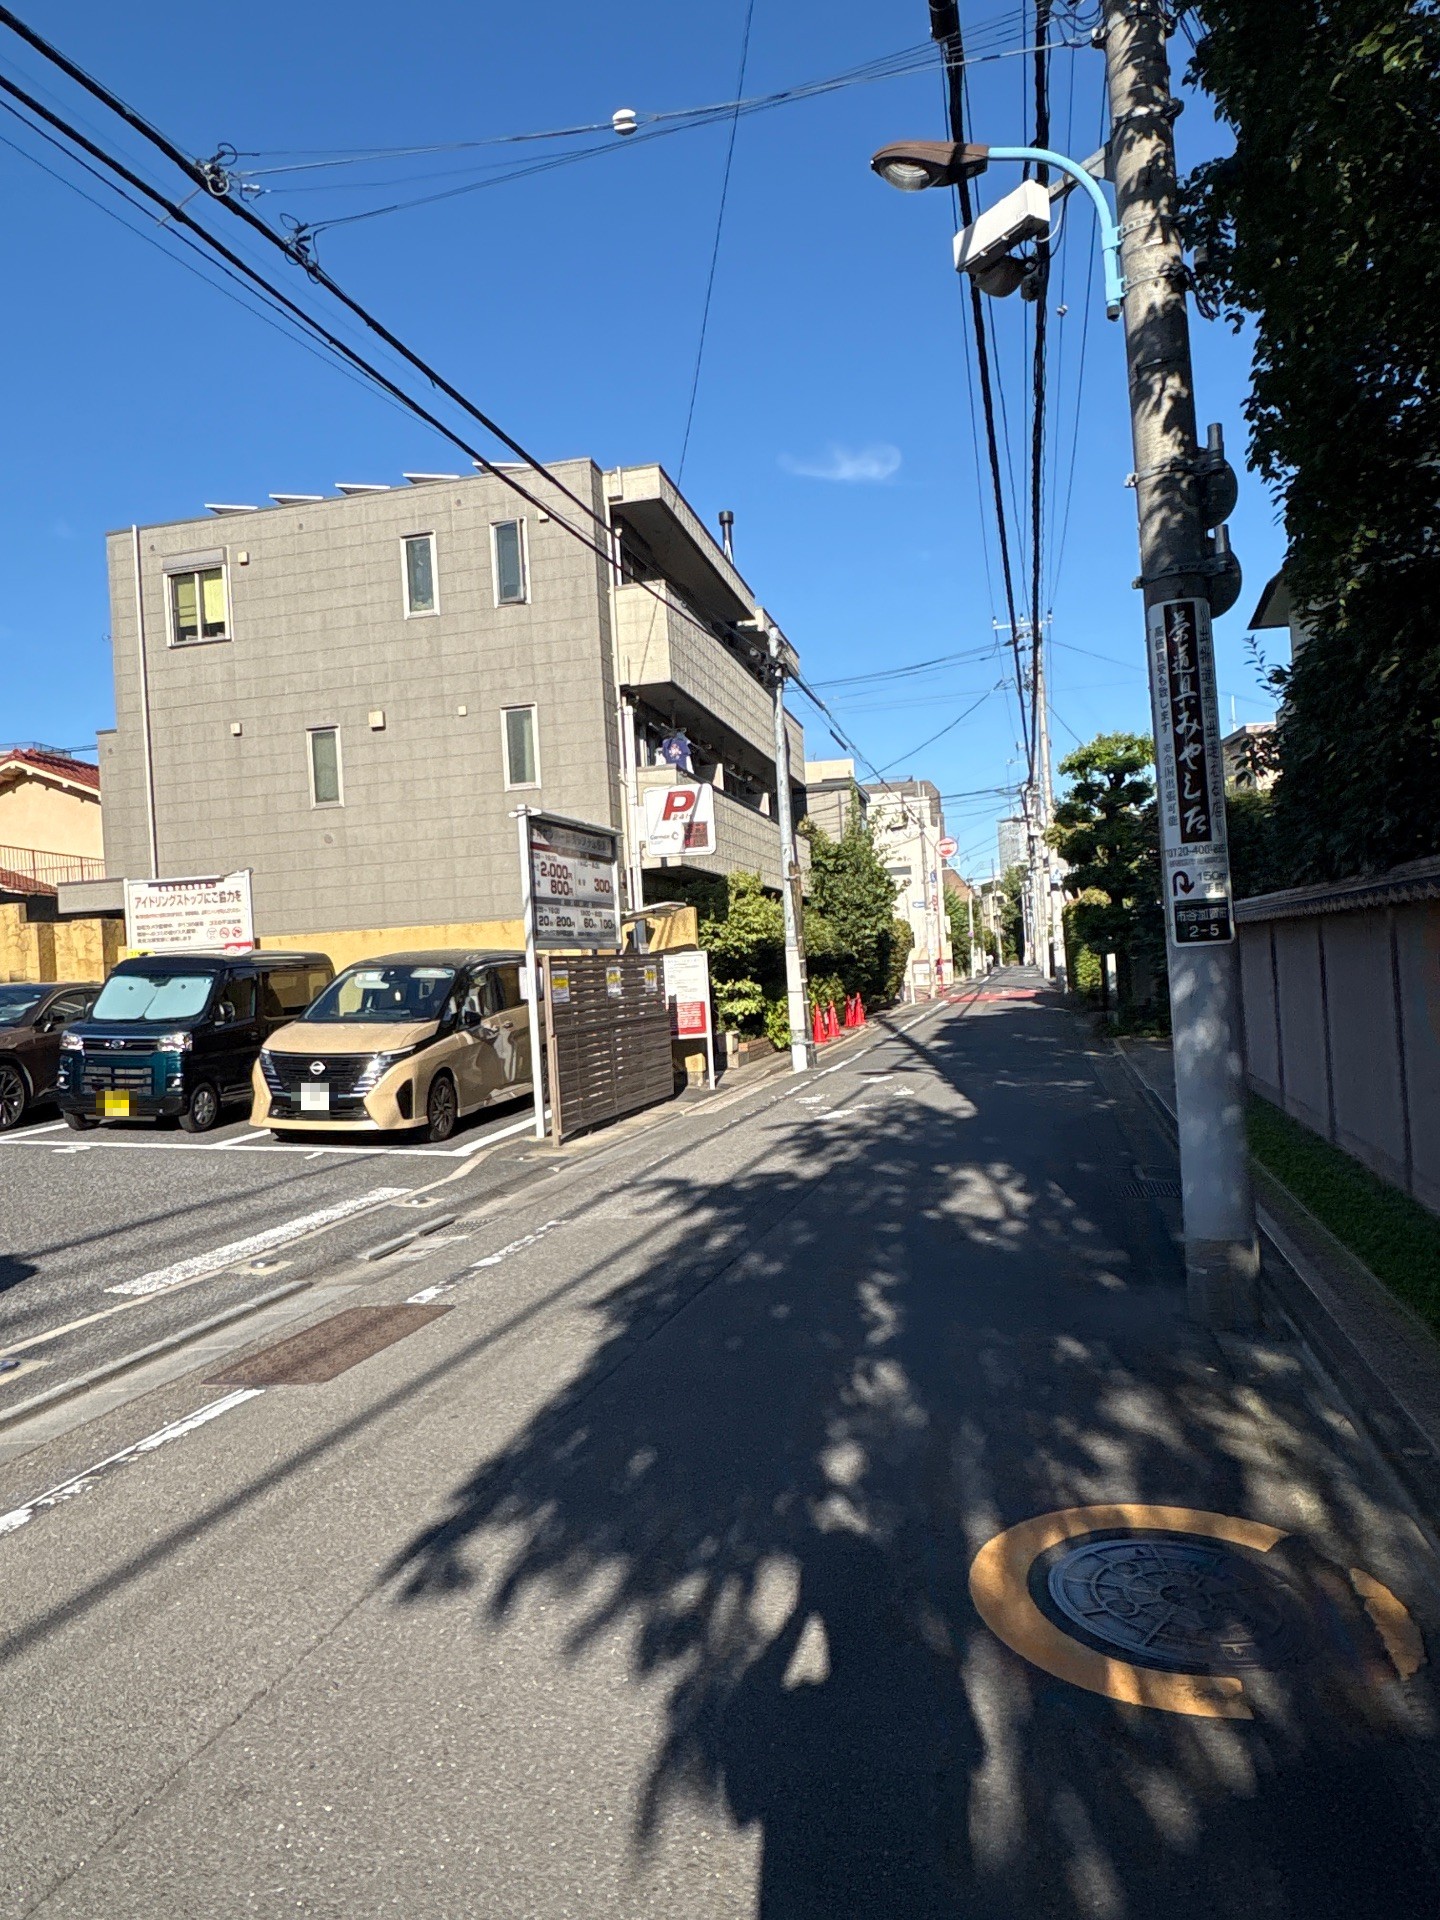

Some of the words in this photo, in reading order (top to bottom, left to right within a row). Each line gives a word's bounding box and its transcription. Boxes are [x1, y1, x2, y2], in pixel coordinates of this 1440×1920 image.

[662, 790, 696, 821] P
[135, 890, 242, 909] アイドリングストップにご協力を
[1189, 923, 1219, 938] 2-5
